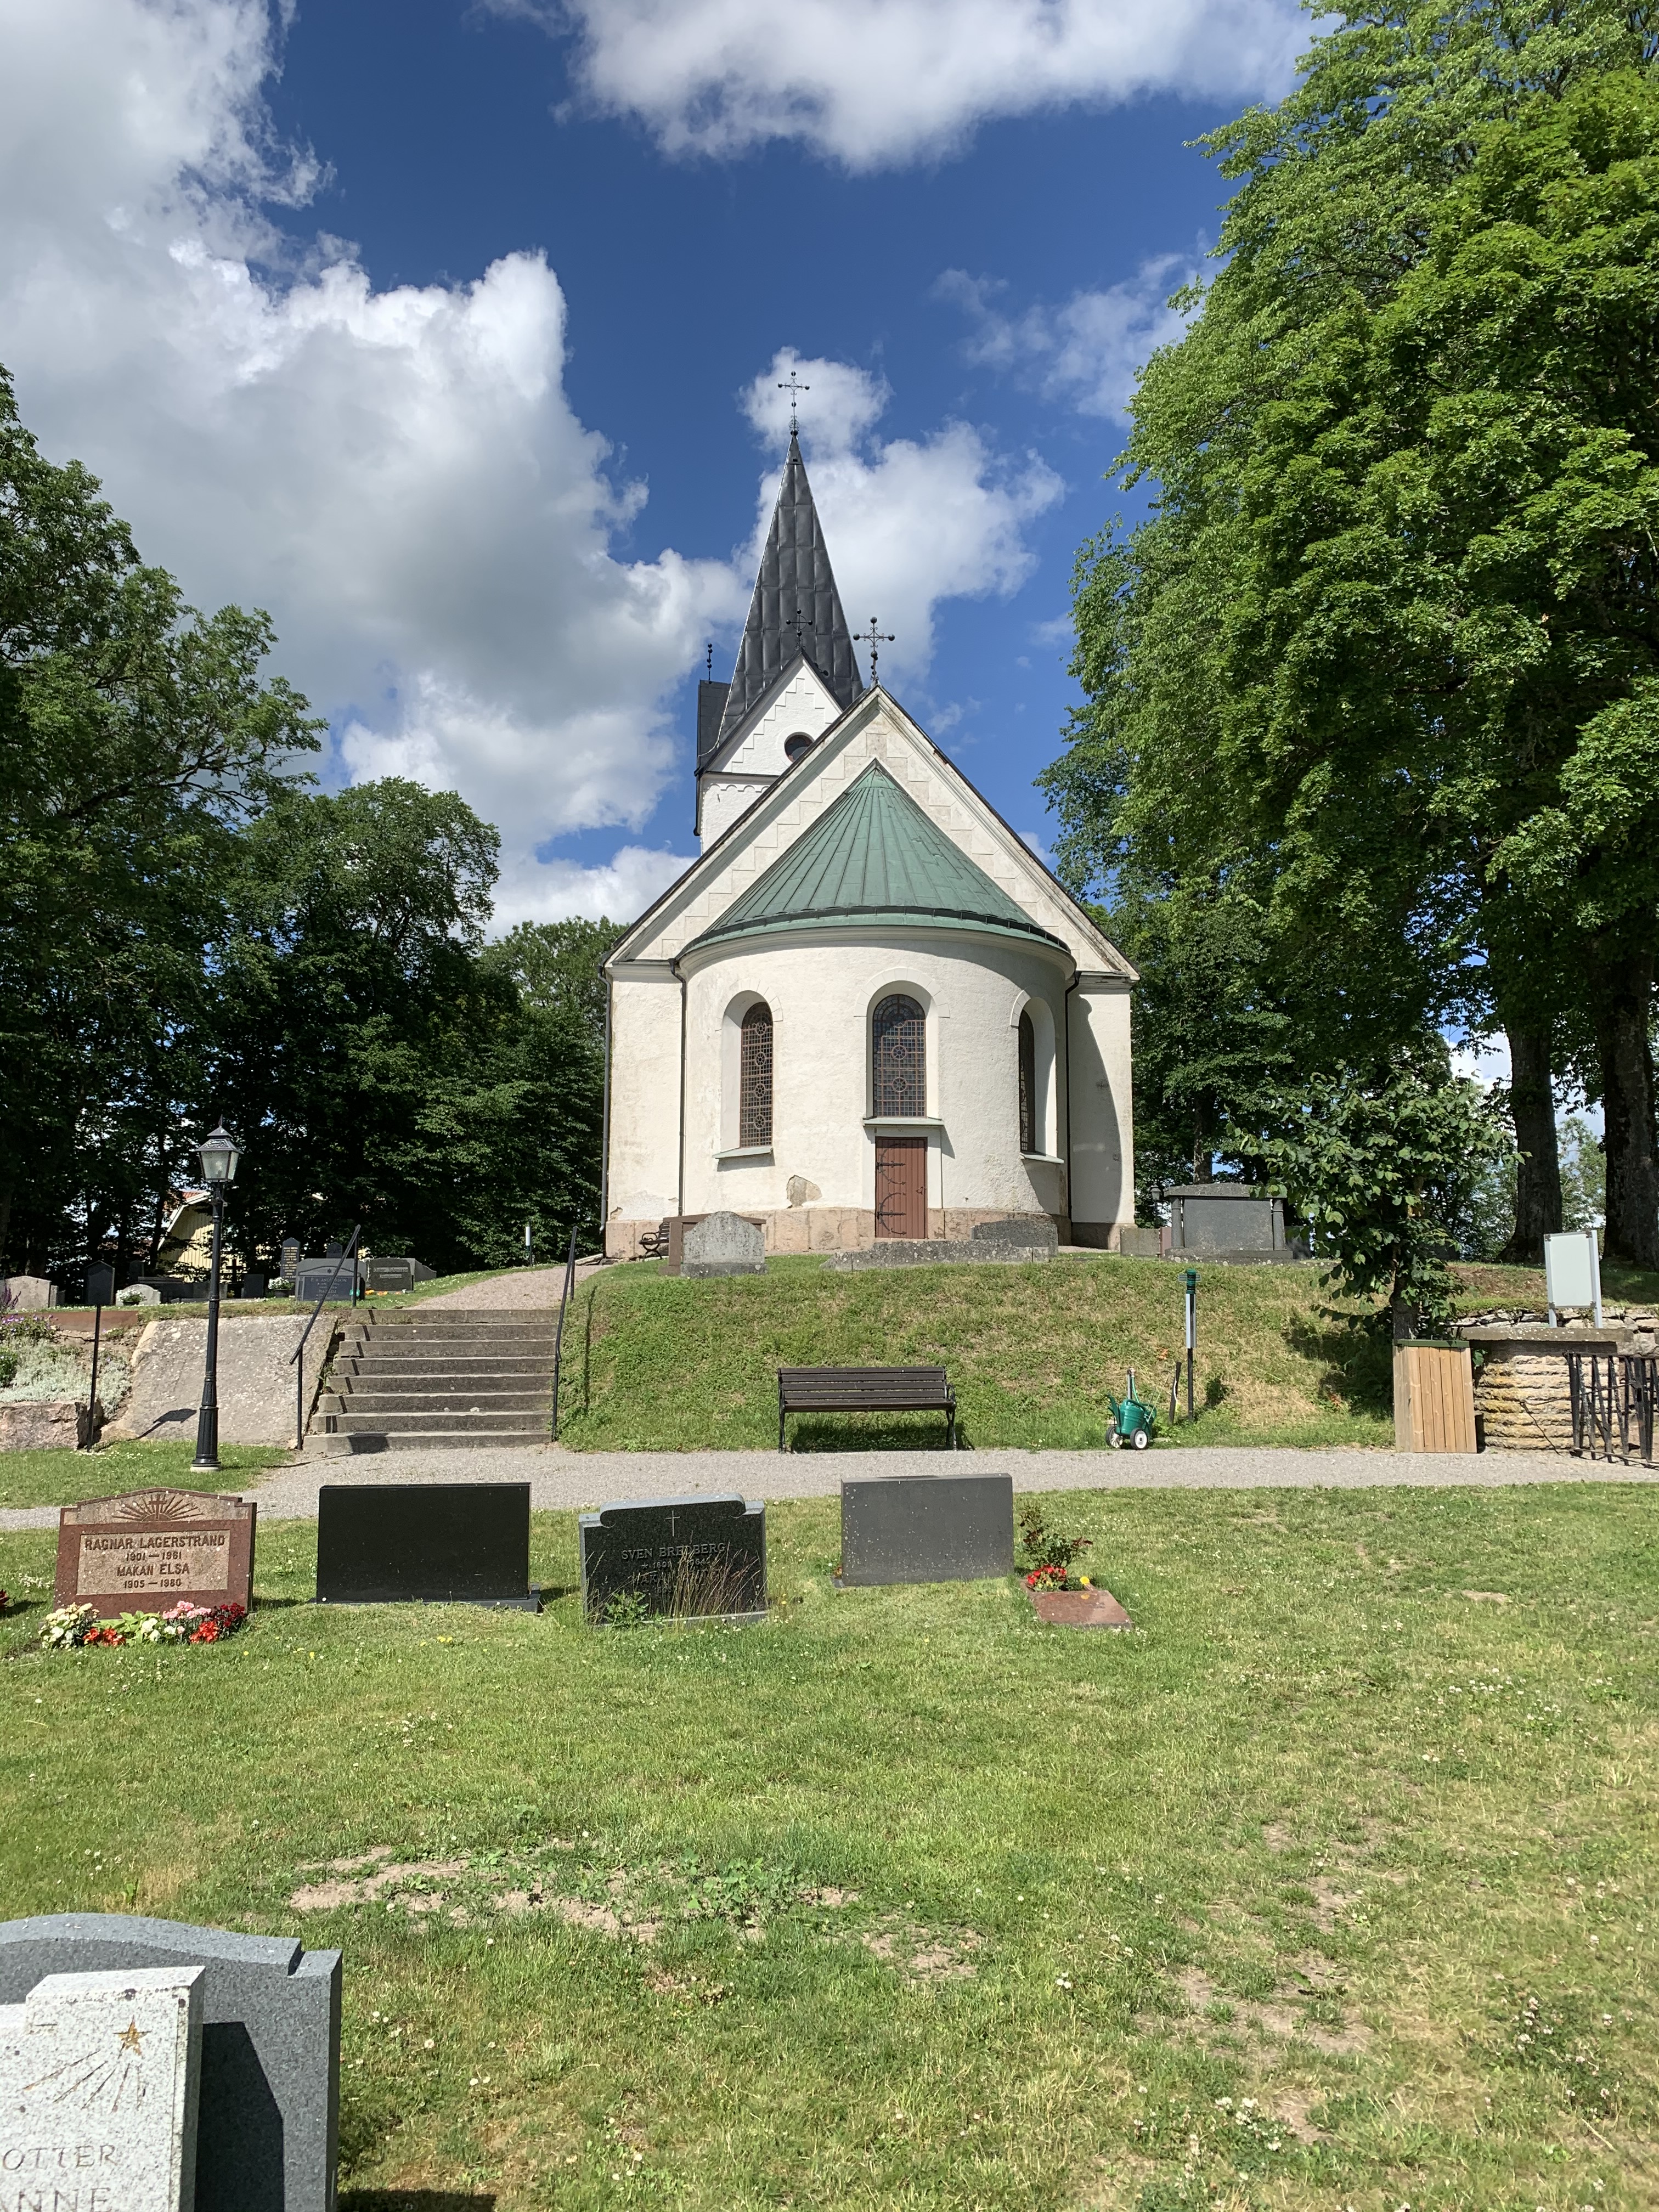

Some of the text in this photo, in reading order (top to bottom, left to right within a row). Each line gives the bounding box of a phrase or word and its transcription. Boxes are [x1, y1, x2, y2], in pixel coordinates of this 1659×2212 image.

[84, 1535, 226, 1550] RAGNAR LAGERSTRAND
[126, 1553, 146, 1561] 1901
[622, 1542, 725, 1559] SVEN BREDBERG
[117, 1563, 190, 1577] MAKAN ELSA
[124, 1579, 145, 1589] 1905
[160, 1578, 182, 1587] 1980
[0, 2187, 111, 2212] NNE
